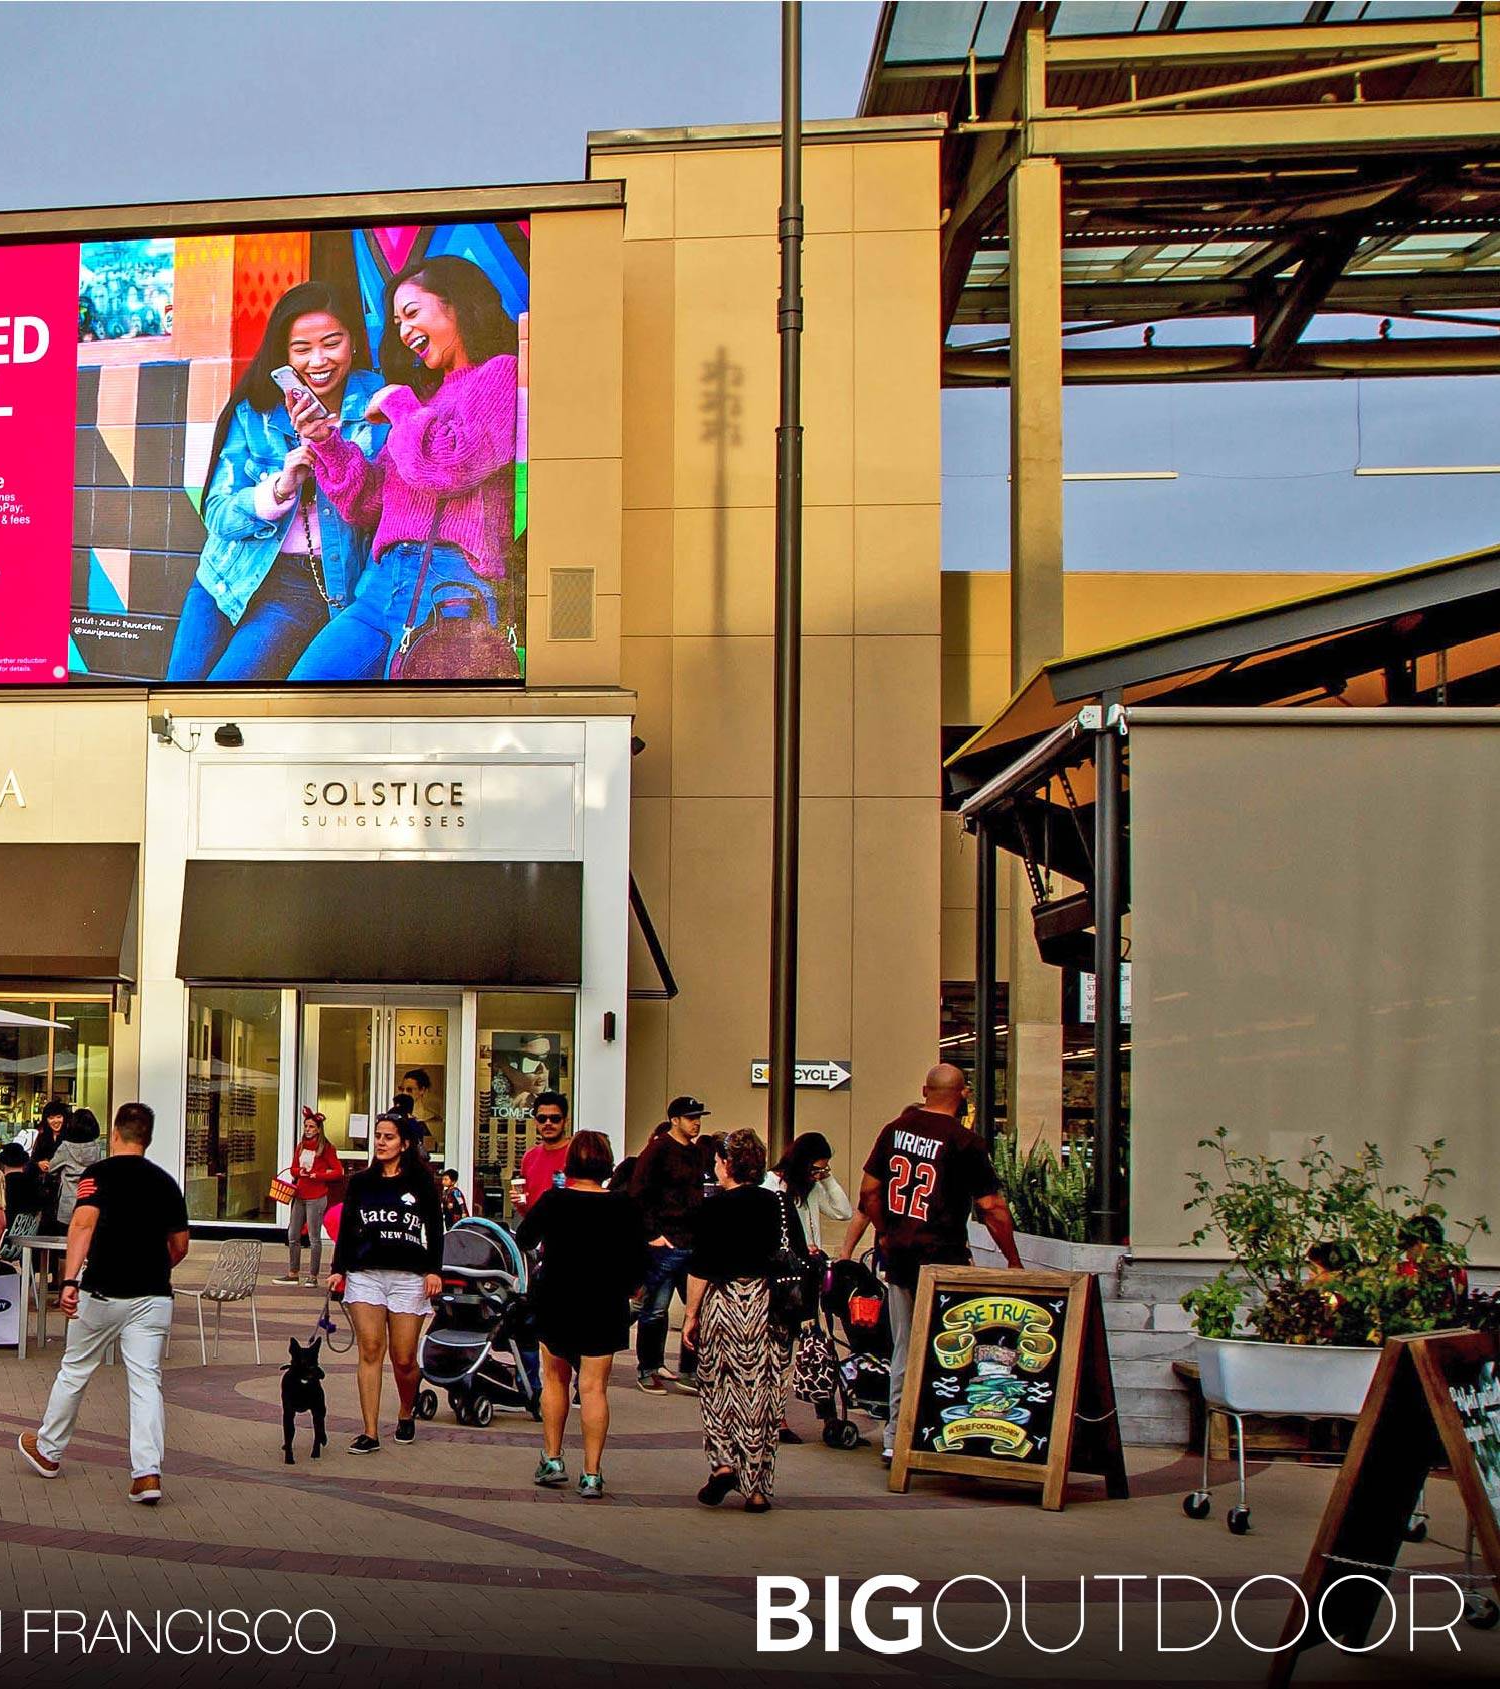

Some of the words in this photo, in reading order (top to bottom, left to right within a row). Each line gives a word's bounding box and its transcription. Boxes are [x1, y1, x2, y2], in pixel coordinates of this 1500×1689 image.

[1, 515, 8, 525] &
[10, 515, 30, 524] fees
[303, 781, 465, 807] SOLSTICE
[301, 816, 465, 828] SUNGLASSES
[893, 1129, 944, 1160] WRIGHT
[888, 1154, 937, 1222] 22
[380, 1230, 403, 1239] NEW
[963, 1304, 986, 1323] BE
[989, 1303, 1037, 1323] TRUE
[943, 1354, 965, 1366] EAT
[1020, 1355, 1042, 1368] WELL
